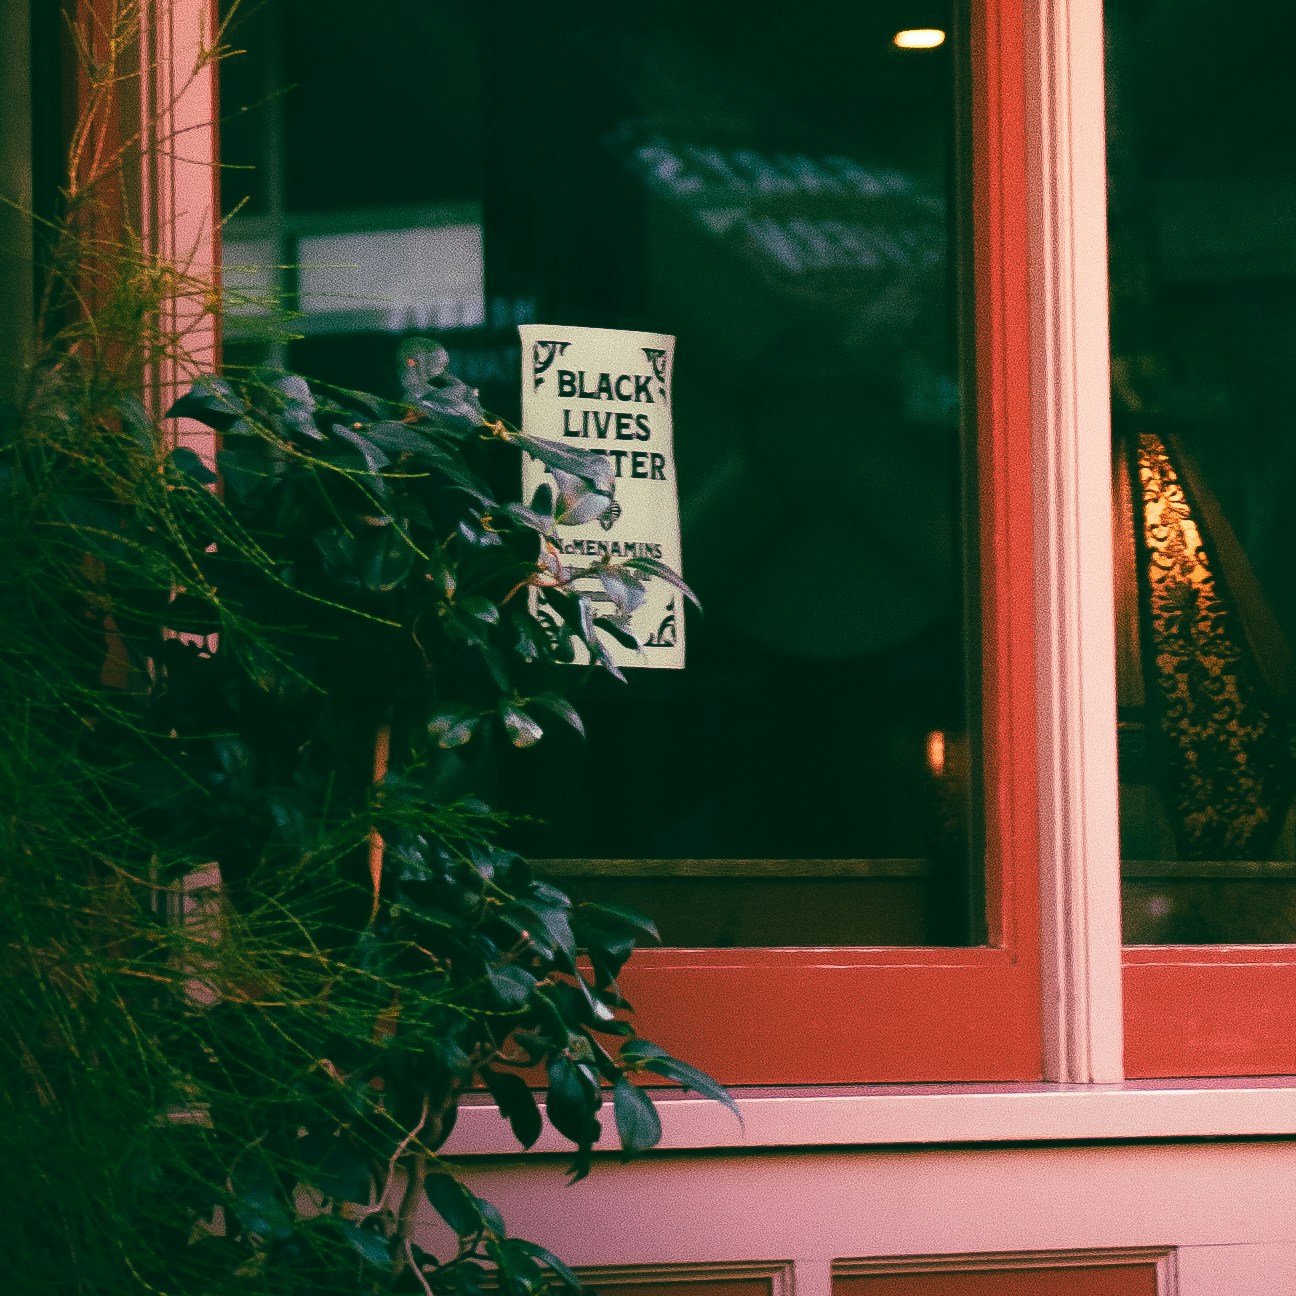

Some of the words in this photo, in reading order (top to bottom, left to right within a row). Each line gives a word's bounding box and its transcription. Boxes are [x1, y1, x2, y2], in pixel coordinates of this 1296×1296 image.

[557, 369, 655, 404] BLACK
[562, 409, 651, 442] LIVES
[544, 448, 667, 481] TER
